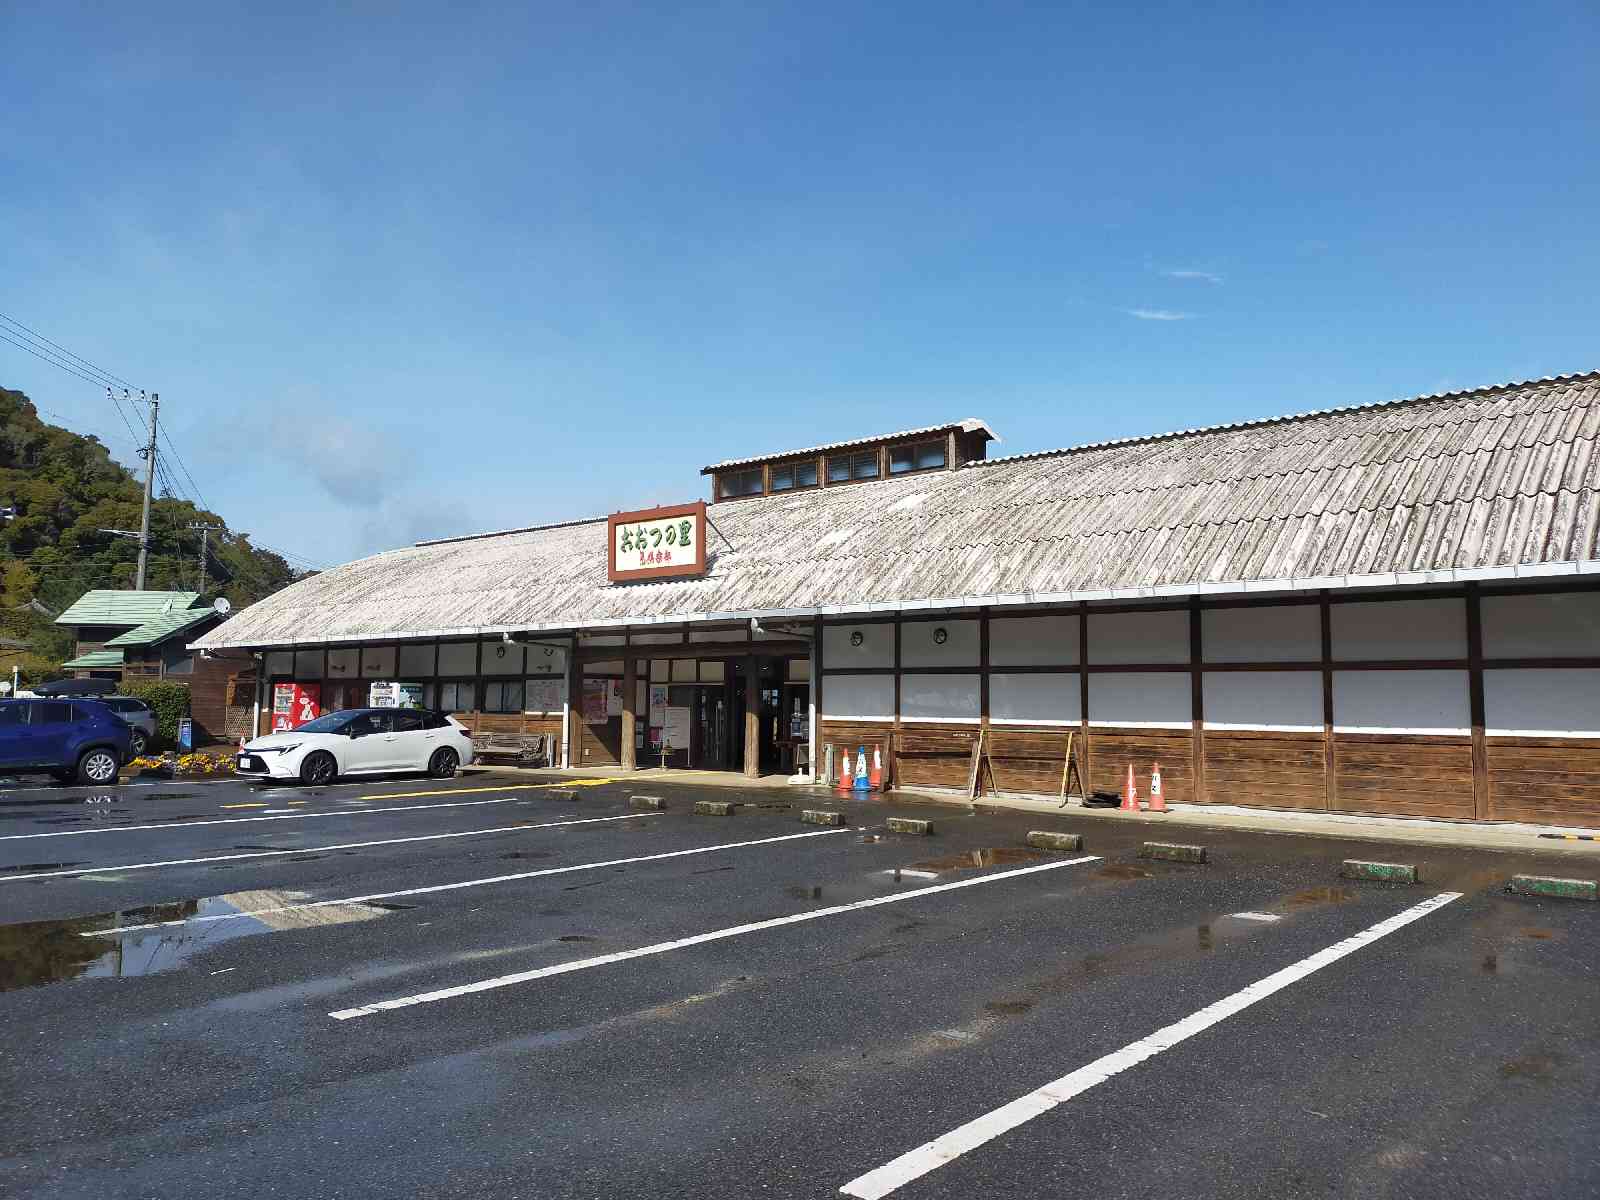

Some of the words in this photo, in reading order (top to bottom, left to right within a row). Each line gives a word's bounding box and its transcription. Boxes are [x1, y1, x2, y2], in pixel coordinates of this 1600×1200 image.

[620, 520, 692, 553] おおつの里
